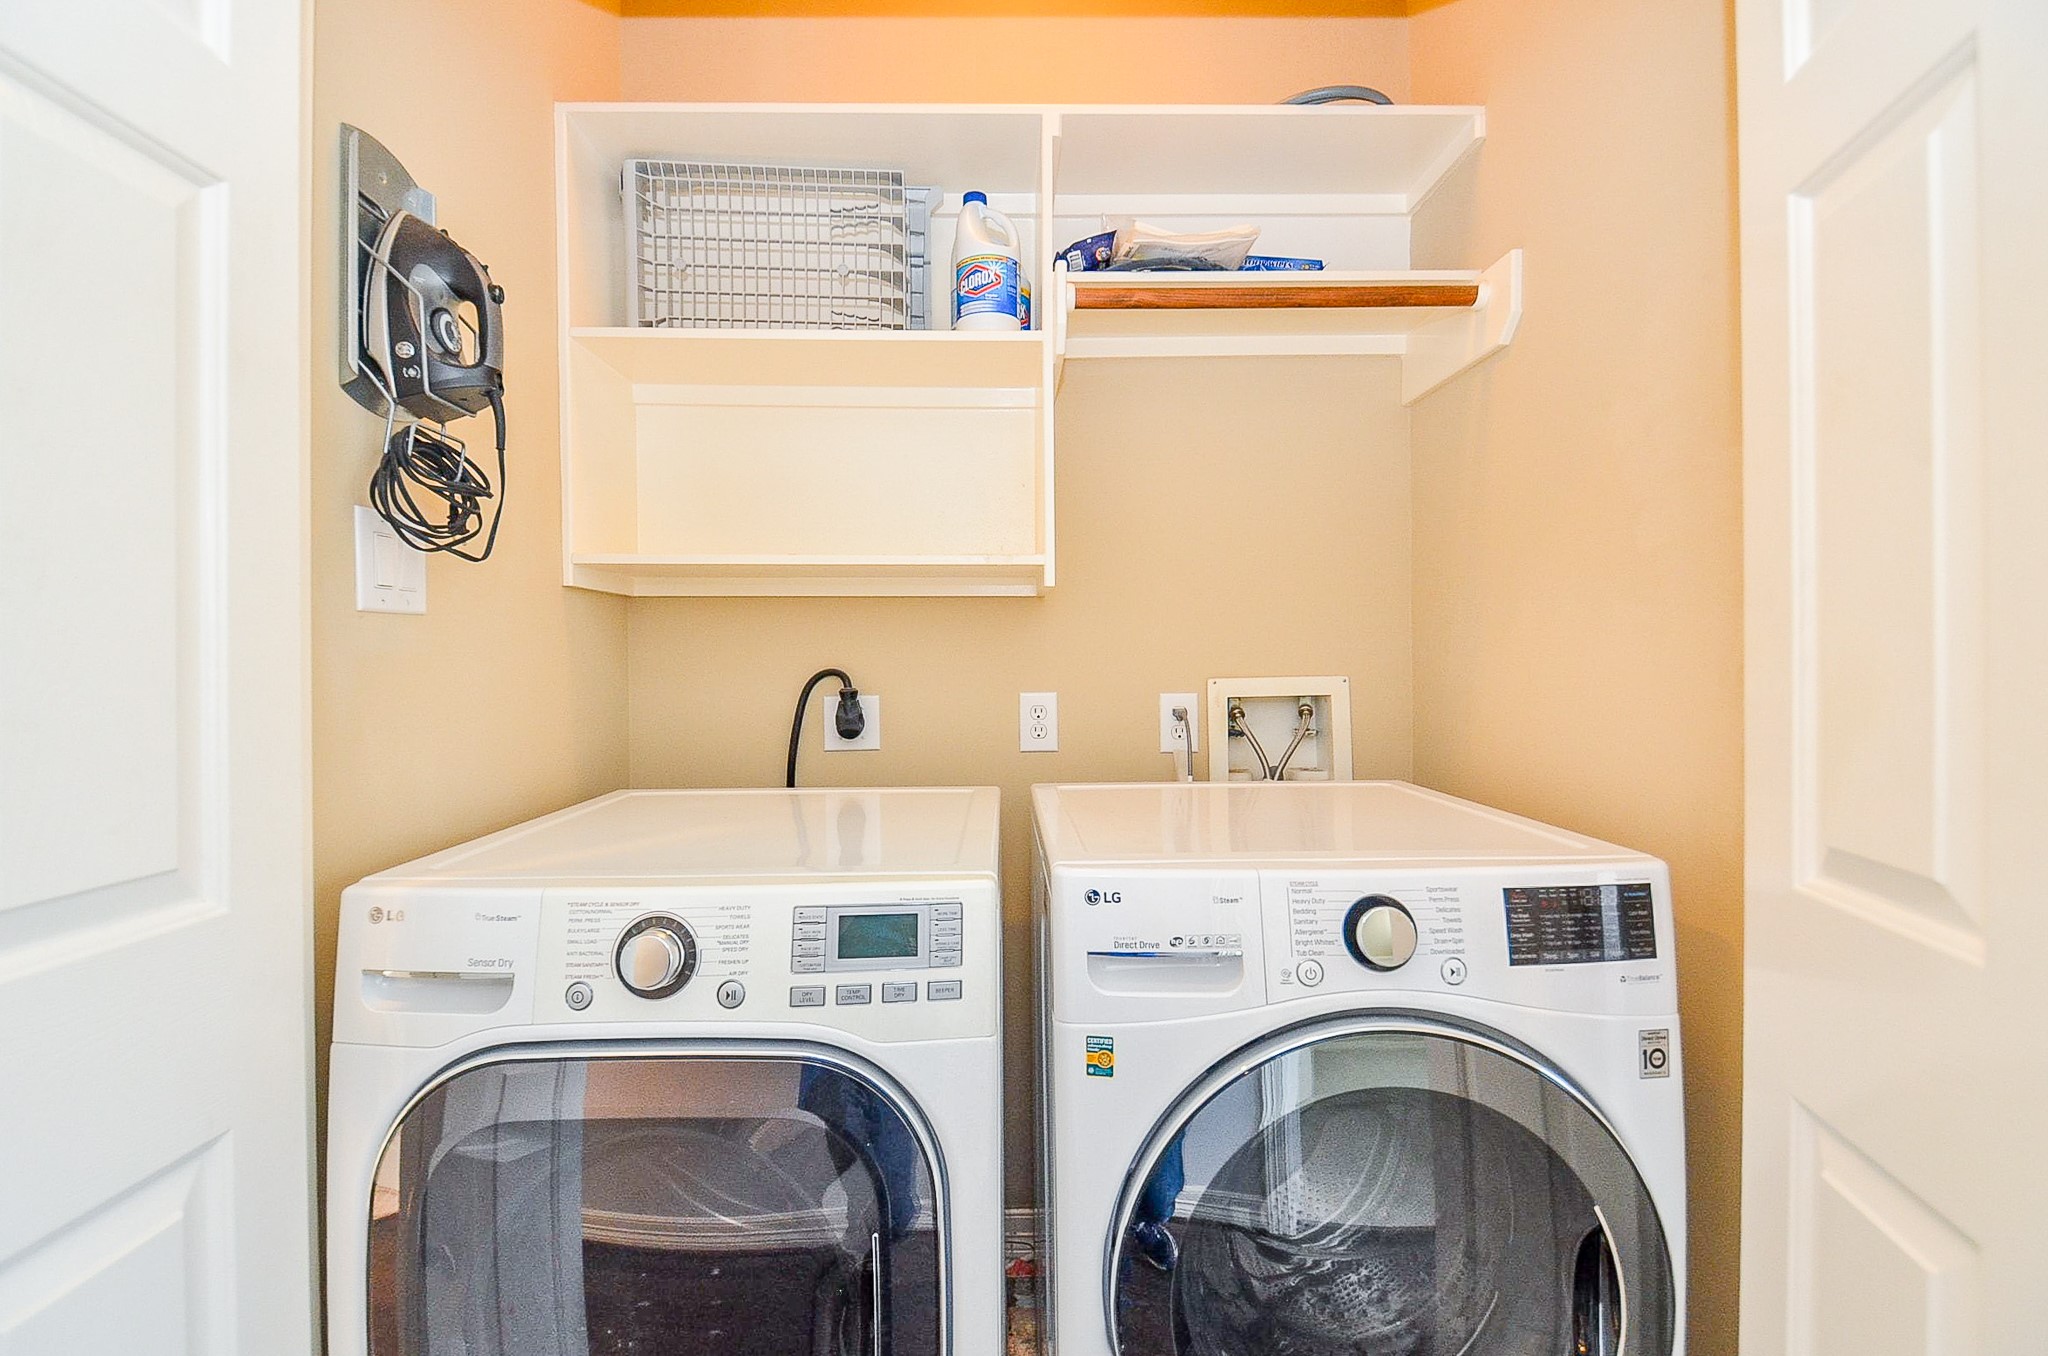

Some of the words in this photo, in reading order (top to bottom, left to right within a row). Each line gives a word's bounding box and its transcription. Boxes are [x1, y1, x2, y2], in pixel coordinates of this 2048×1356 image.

[961, 268, 996, 296] CLOROX
[1104, 892, 1121, 903] LG
[387, 910, 405, 921] LG
[1114, 941, 1137, 949] Direct
[1140, 941, 1160, 949] Drive
[468, 958, 496, 967] Sensor
[498, 958, 514, 969] Dry
[1642, 1048, 1666, 1069] 10
